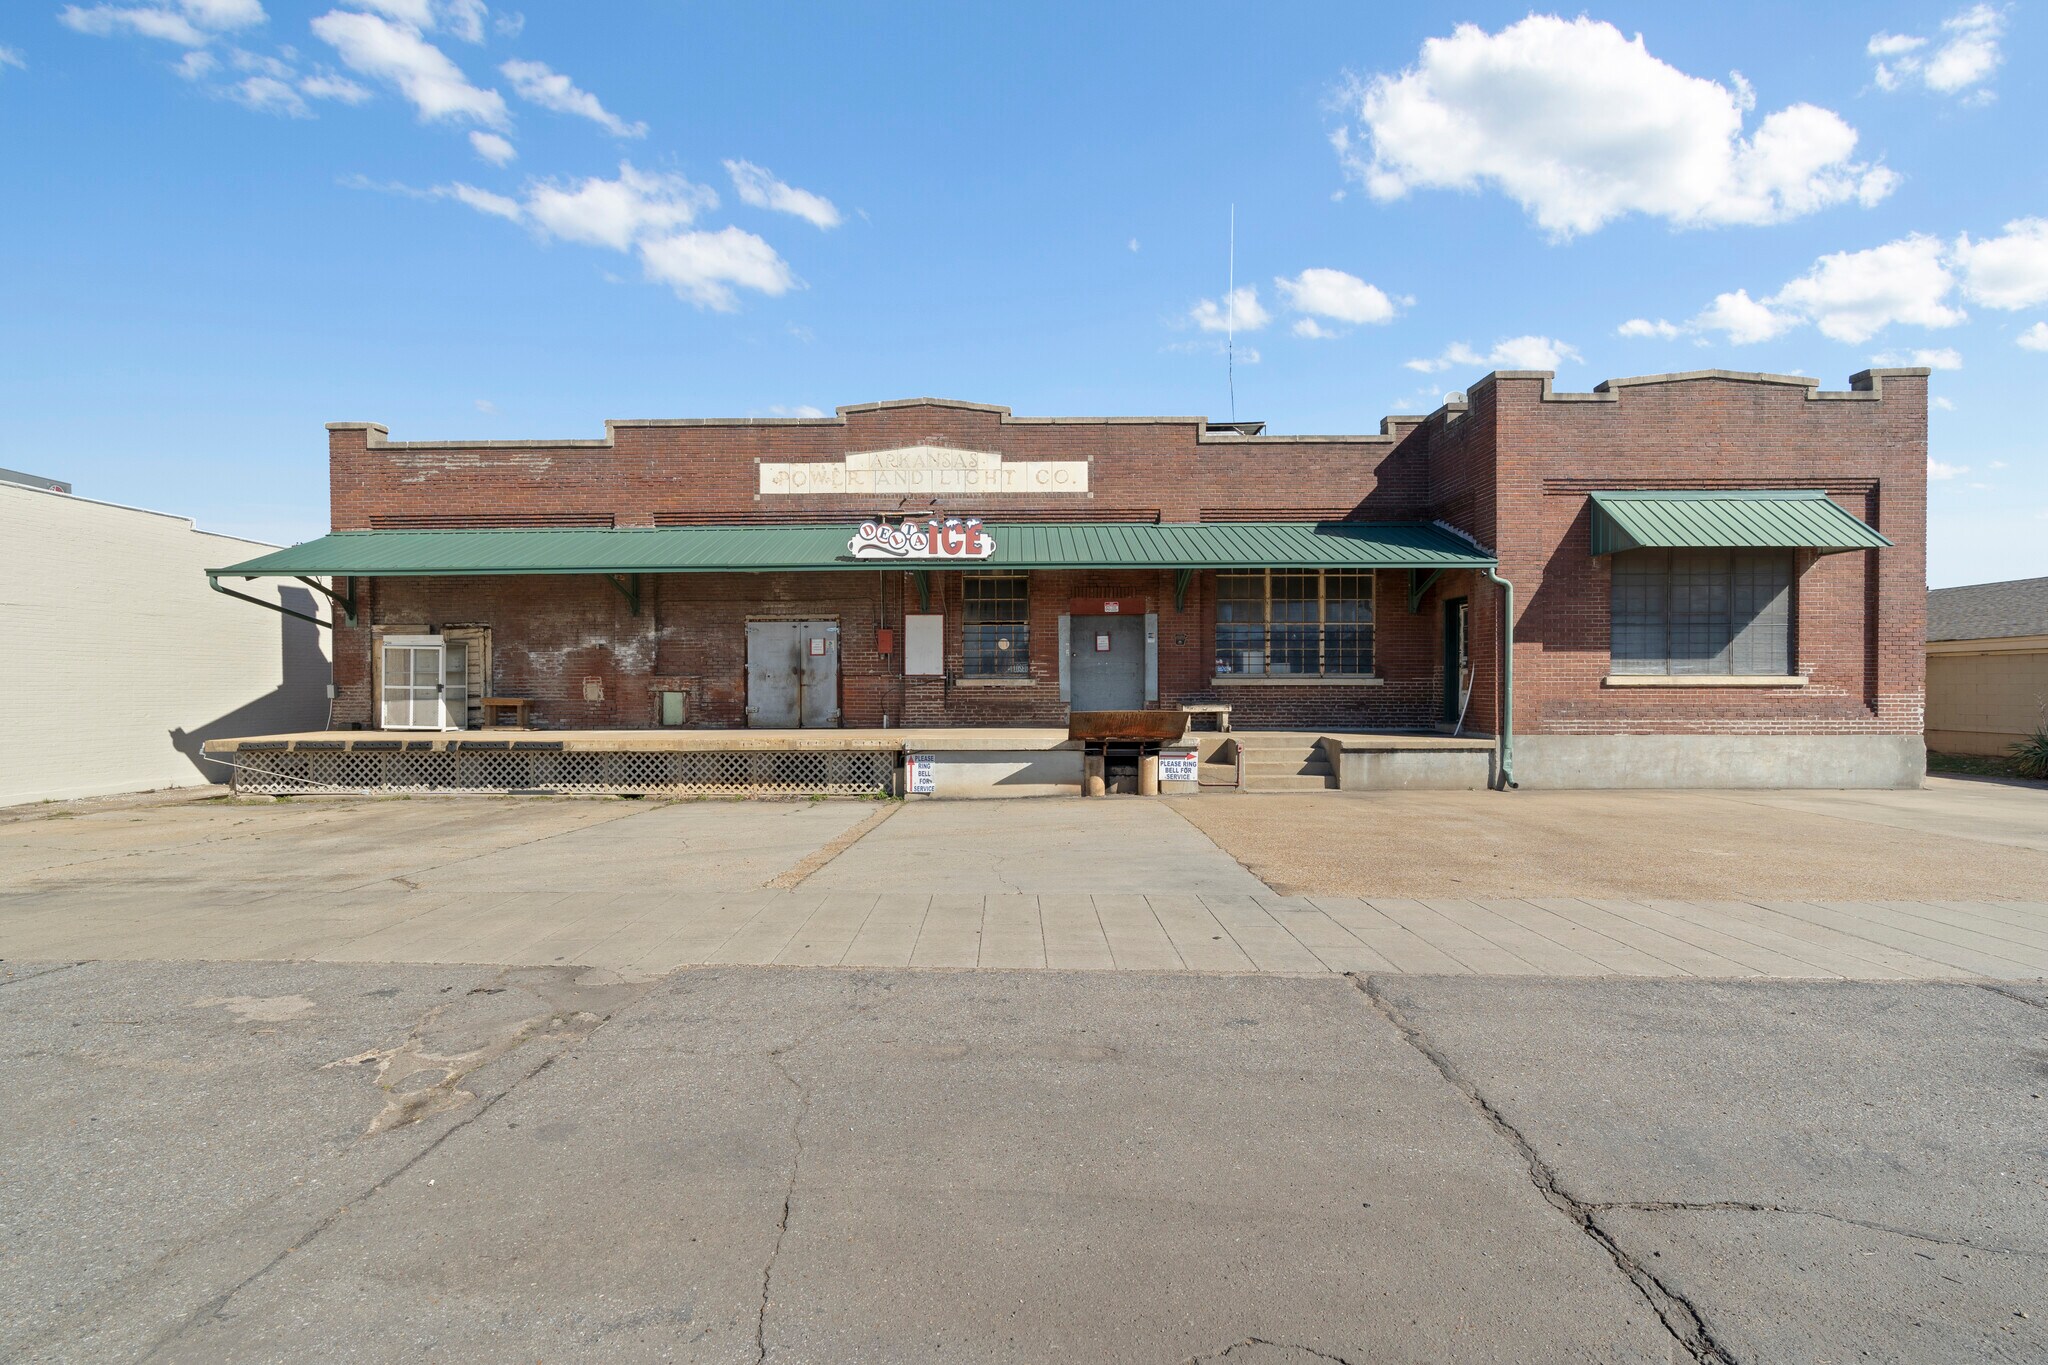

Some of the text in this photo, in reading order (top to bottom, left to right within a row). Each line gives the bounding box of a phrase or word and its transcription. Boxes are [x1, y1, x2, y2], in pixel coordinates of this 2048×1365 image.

[870, 452, 979, 469] ARKANSAS
[777, 469, 1077, 487] POWER AND LIGHT CO.
[860, 518, 984, 555] DELTA ICE
